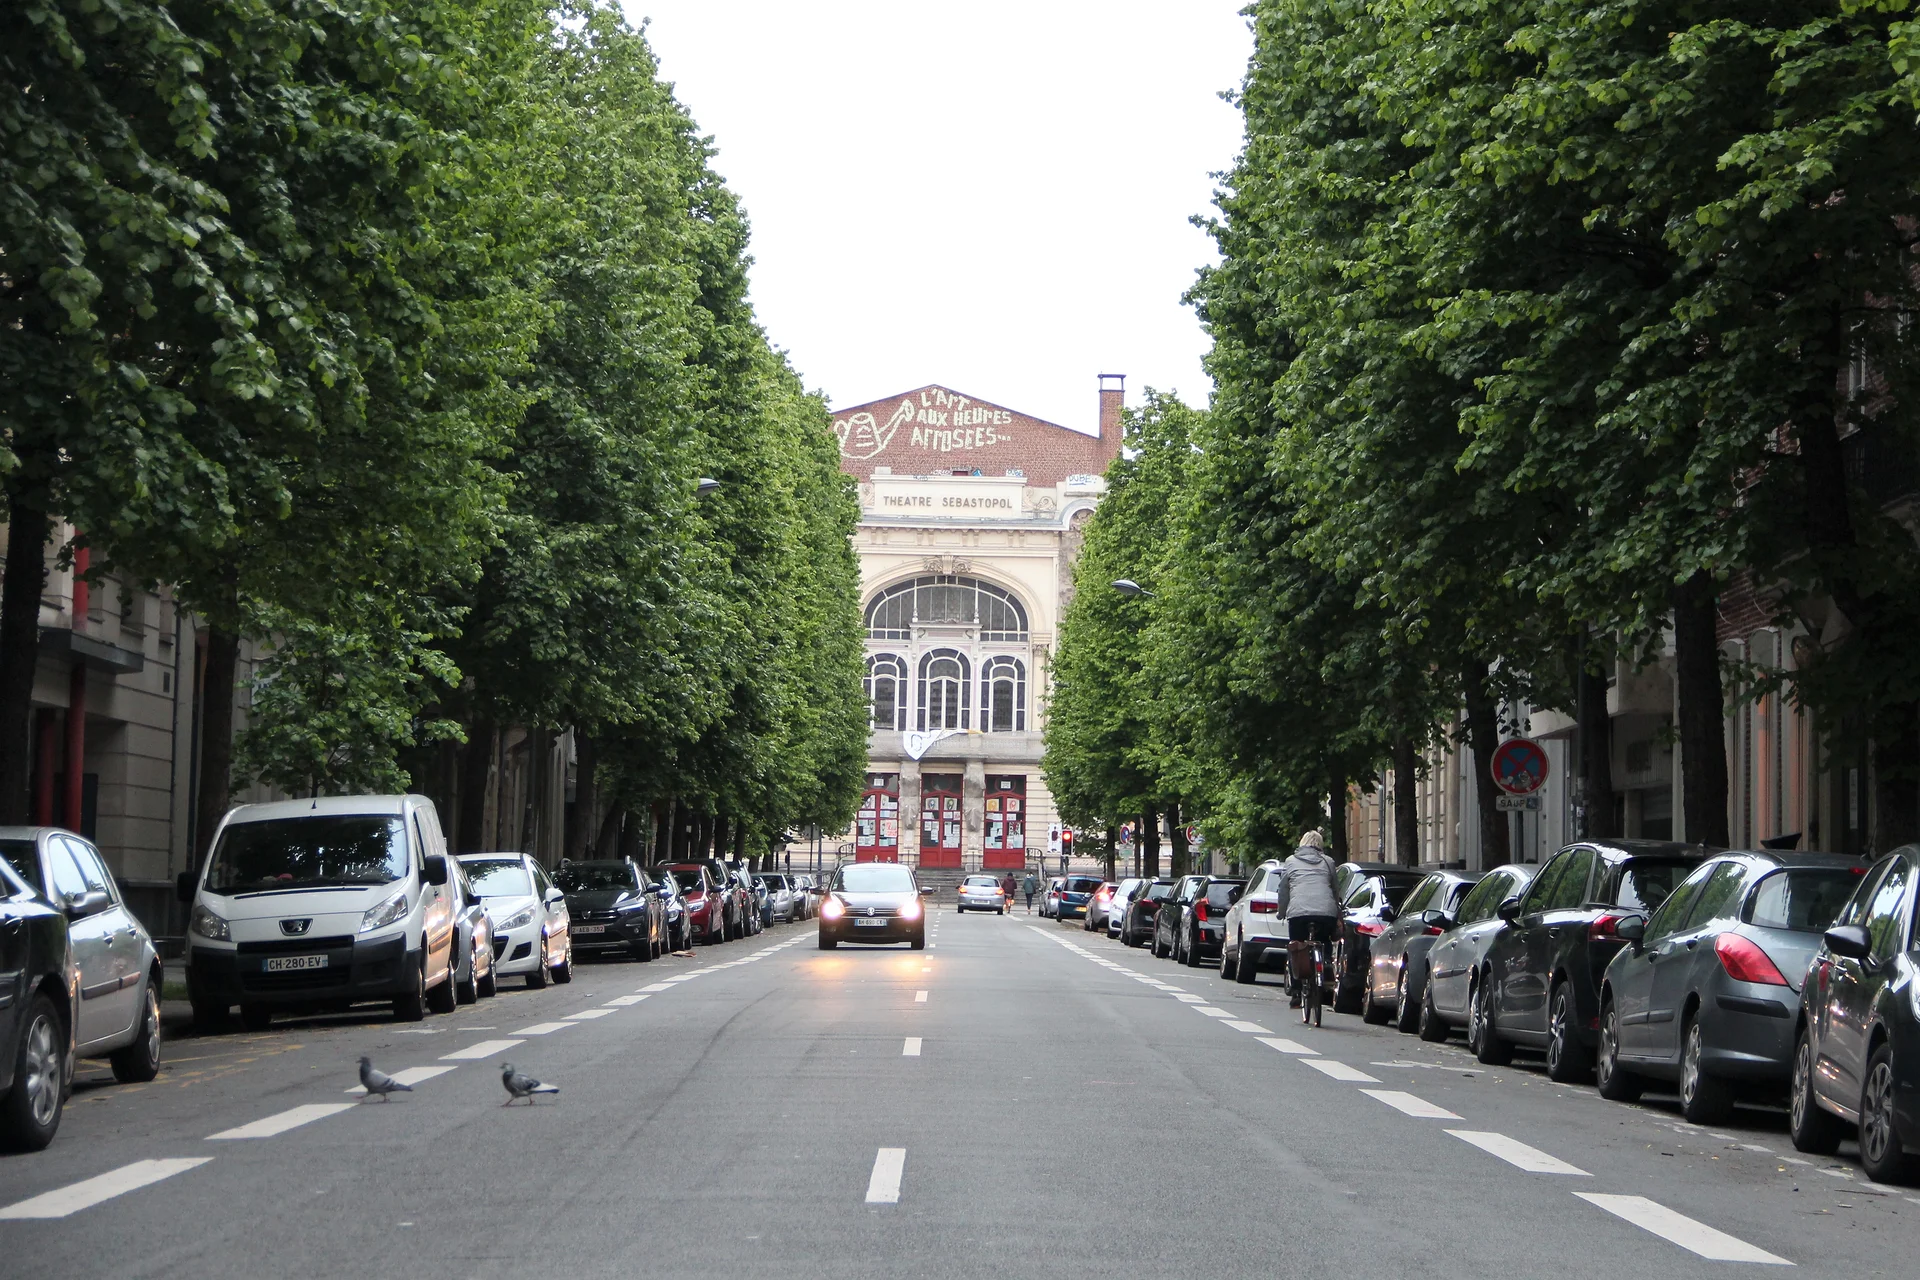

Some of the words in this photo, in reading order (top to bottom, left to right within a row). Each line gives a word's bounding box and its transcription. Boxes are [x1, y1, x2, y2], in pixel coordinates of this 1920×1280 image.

[916, 408, 948, 427] AUX
[883, 495, 932, 507] THEATRE
[942, 497, 1012, 509] SEBASTOPOL
